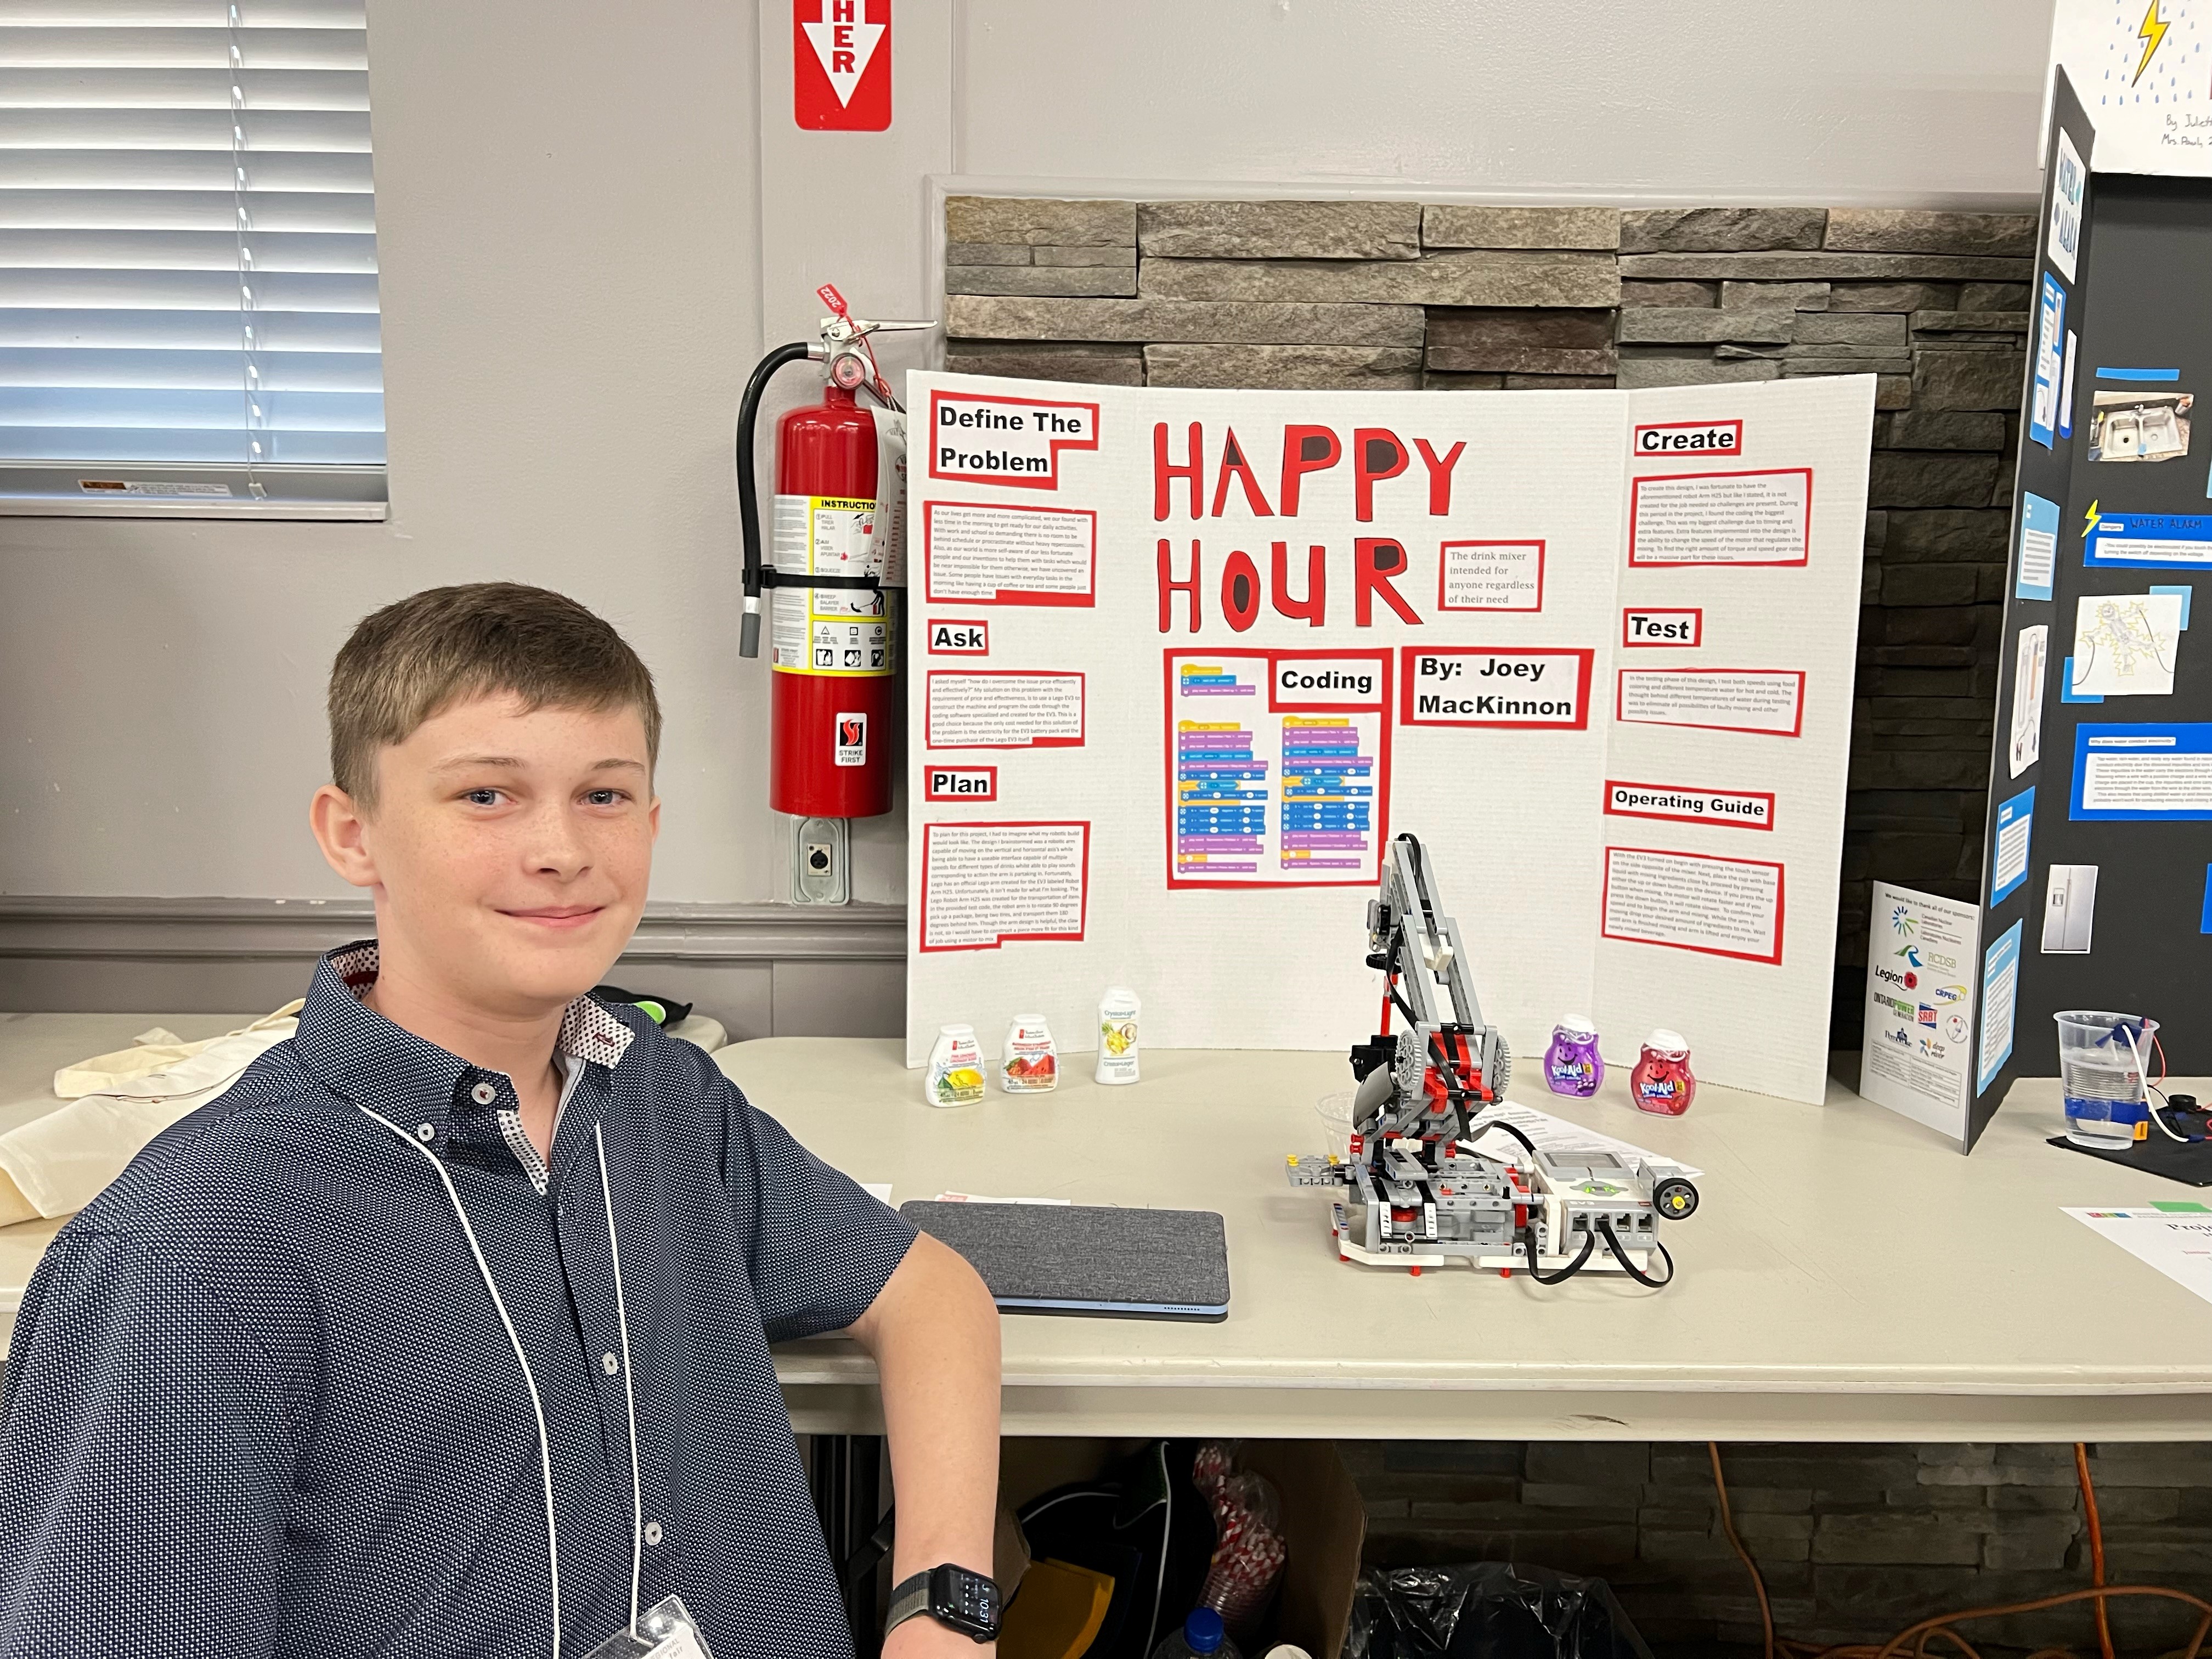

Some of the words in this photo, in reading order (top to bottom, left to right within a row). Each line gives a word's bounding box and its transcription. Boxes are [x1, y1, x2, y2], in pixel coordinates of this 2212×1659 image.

[2166, 114, 2177, 131] By
[2161, 133, 2179, 145] Mrs.
[821, 287, 842, 308] 2022
[940, 406, 1024, 430] Define
[1033, 413, 1082, 433] The
[1642, 429, 1734, 450] Create
[940, 448, 1048, 472] Problem
[1154, 421, 1468, 522] HAPPY
[821, 500, 876, 509] INSTRUCTIO
[2130, 518, 2164, 529] WATER
[2170, 518, 2202, 529] ALARM
[1451, 551, 1468, 560] The
[1471, 552, 1496, 560] drink
[1494, 566, 1509, 574] for
[1158, 537, 1424, 633] HOUR
[1486, 581, 1534, 590] regardless
[1449, 595, 1458, 603] of
[934, 627, 984, 647] Ask
[1631, 617, 1689, 639] Test
[1421, 658, 1462, 680] By:
[1480, 658, 1545, 682] Joey
[1282, 671, 1372, 693] Coding
[1419, 695, 1571, 715] MacKinnon
[933, 774, 988, 793] Plan
[1615, 791, 1704, 812] Operating
[1711, 798, 1765, 816] Guide
[1928, 952, 1956, 969] RCDSB
[1875, 965, 1903, 984] Legion
[1936, 989, 1957, 1000] CRPEG
[1918, 1011, 1937, 1022] SRBT
